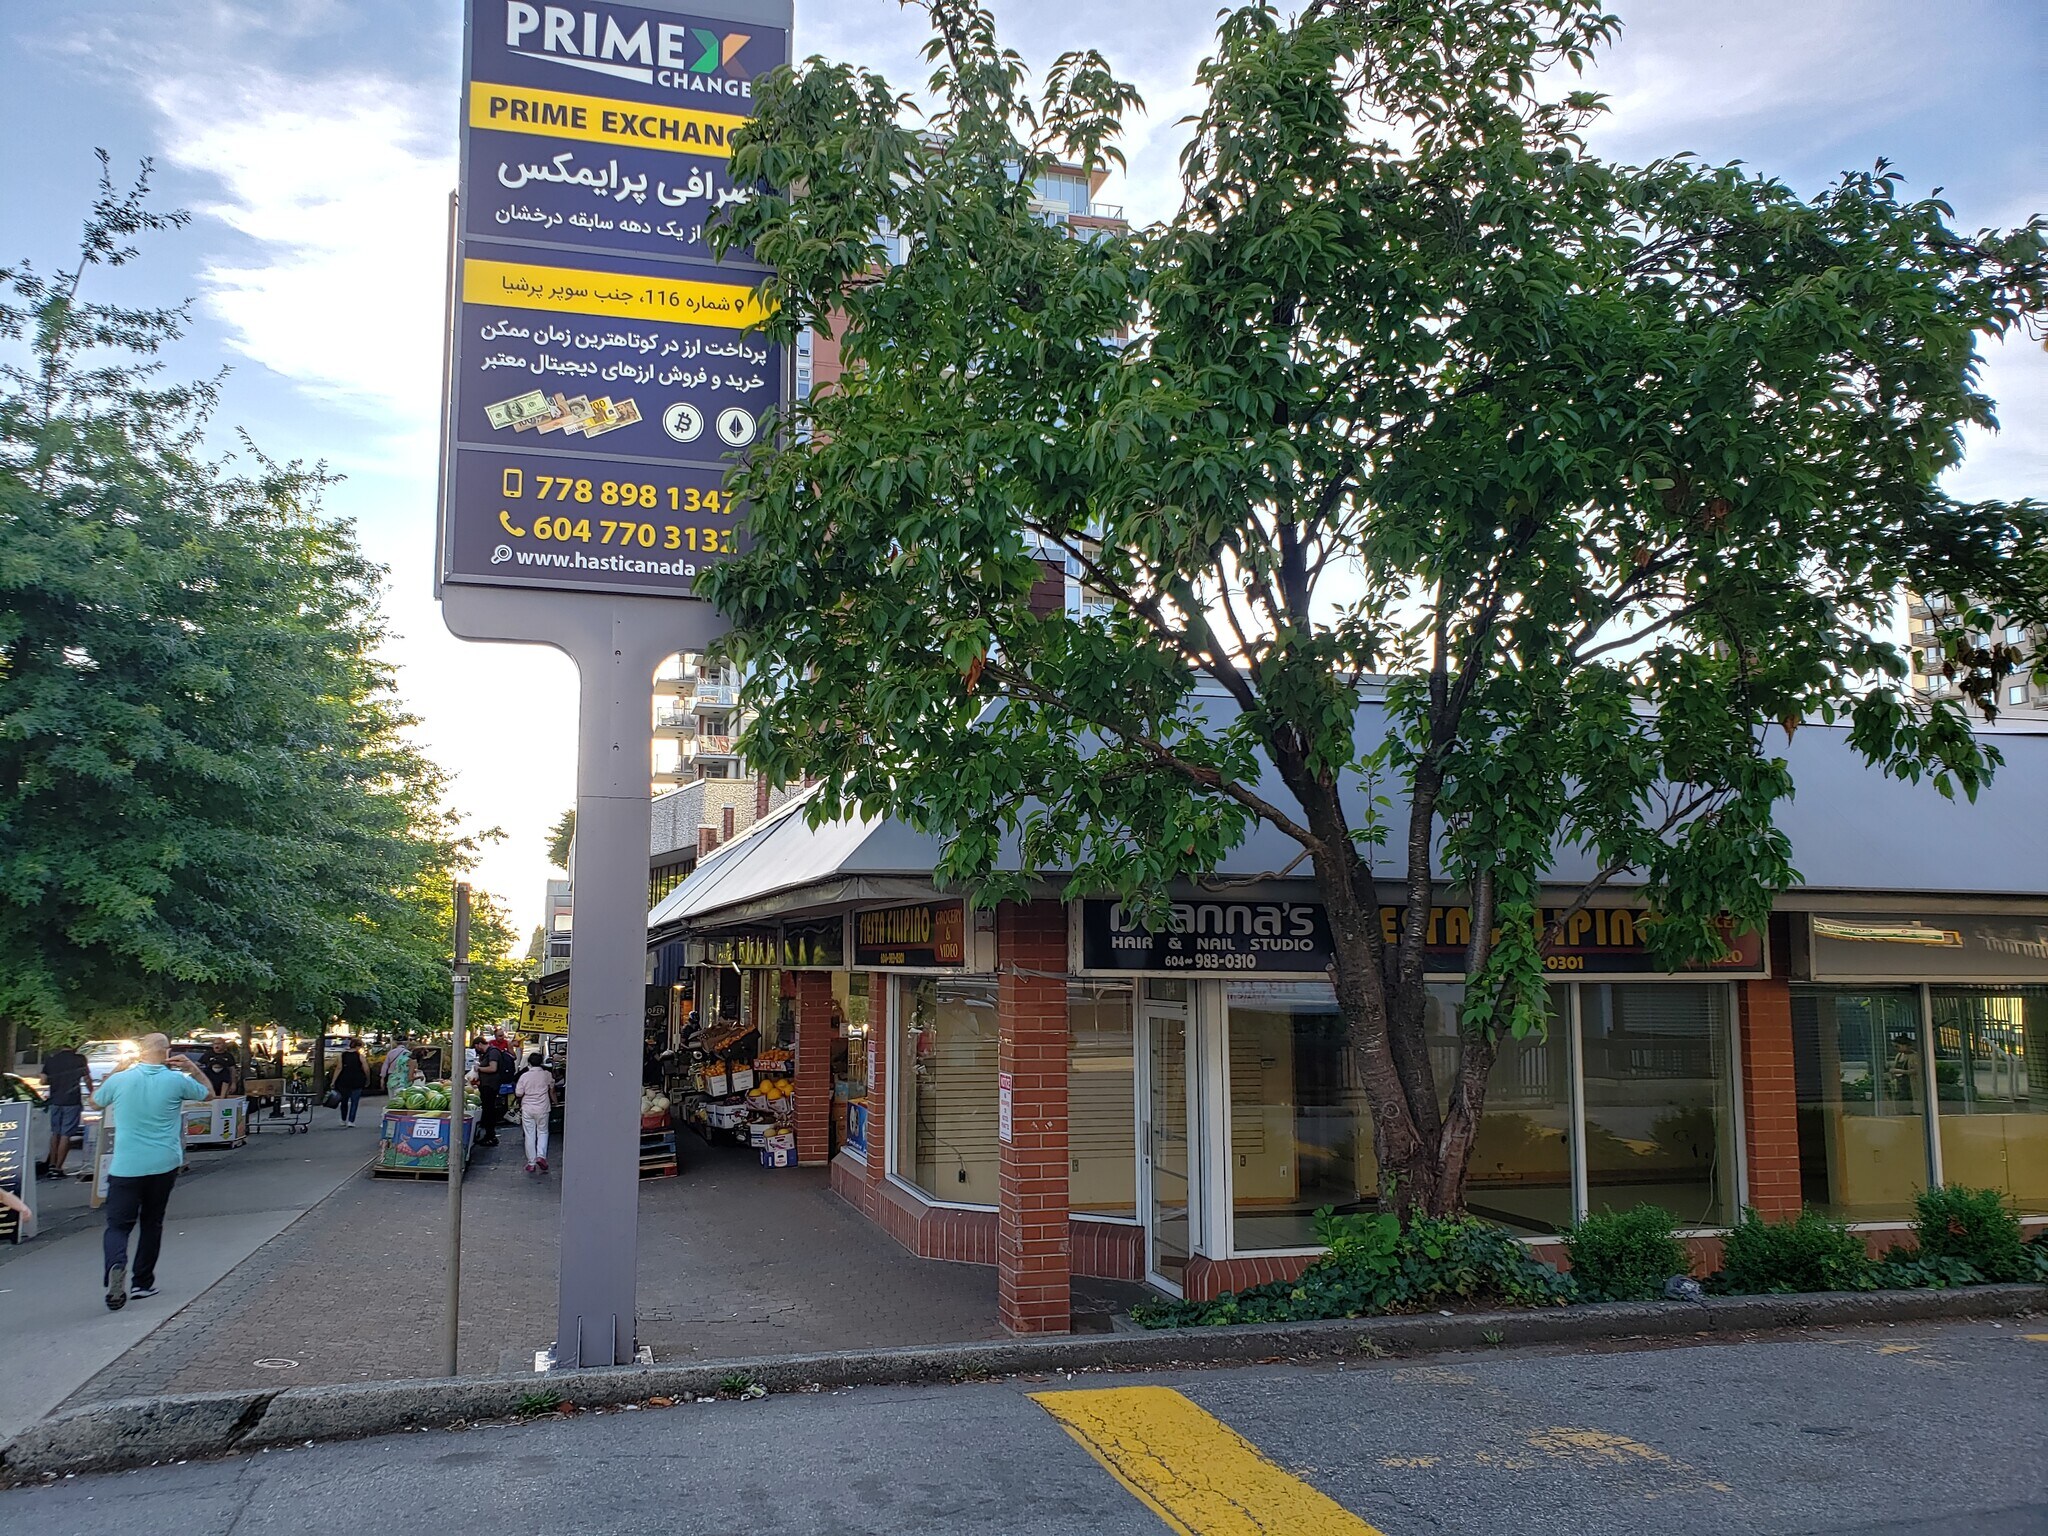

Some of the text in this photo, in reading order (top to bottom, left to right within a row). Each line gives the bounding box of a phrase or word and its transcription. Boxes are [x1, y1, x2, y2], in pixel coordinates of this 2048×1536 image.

[657, 70, 752, 99] CHANGE
[489, 96, 587, 130] PRIME
[498, 152, 648, 205] پرایمکس
[495, 204, 563, 229] درخشان
[568, 212, 614, 232] سابقه
[619, 219, 651, 234] دهه
[656, 220, 684, 242] یک
[688, 224, 701, 244] از
[502, 275, 543, 299] پرشیا
[548, 285, 588, 301] سوپر
[594, 288, 633, 305] جنب
[686, 295, 730, 314] شماره
[480, 320, 767, 366] پرداخت ارز در کوتاهترین زمان ممکن
[480, 352, 765, 393] خرید و فروش ارزهای دیجیتال معتبر
[535, 475, 593, 503] 778
[600, 481, 657, 508] 898
[533, 516, 592, 543] 604
[600, 520, 656, 547] 770
[516, 551, 698, 577] www.hasticanada
[859, 906, 931, 945] FIESTA FILIPINO
[935, 907, 963, 925] GROCERY
[945, 926, 951, 940] &
[1111, 936, 1314, 951] HAIR & NAIL STUDIO
[939, 943, 958, 958] VIDEO
